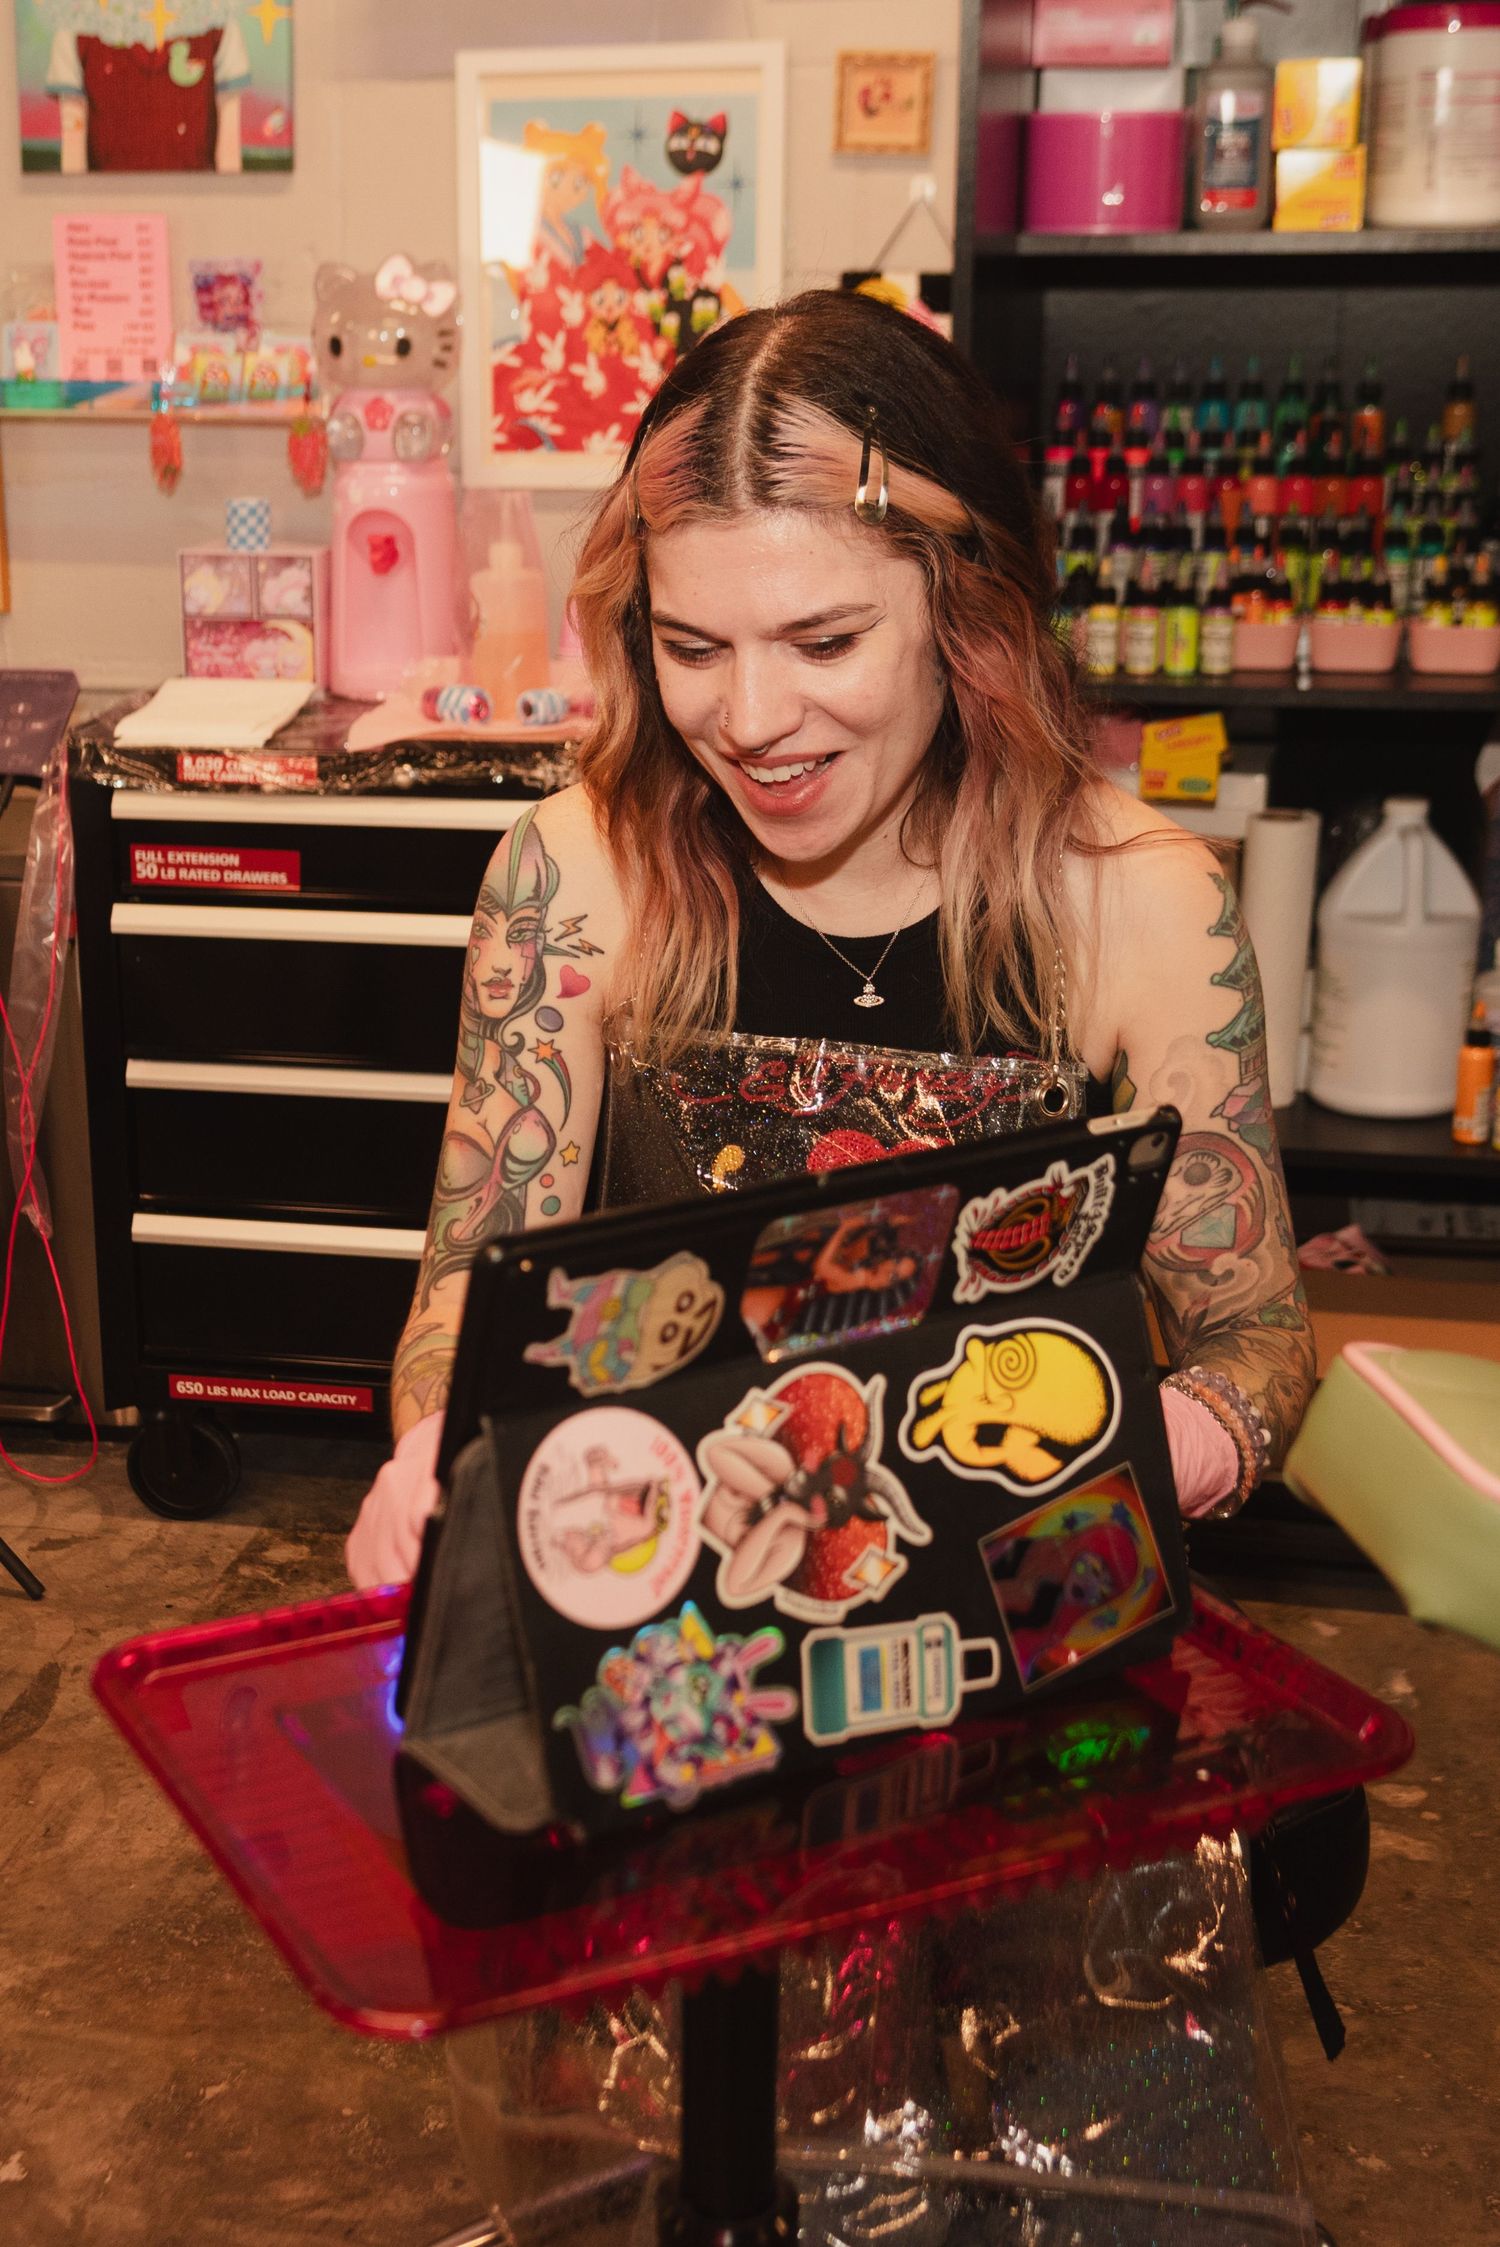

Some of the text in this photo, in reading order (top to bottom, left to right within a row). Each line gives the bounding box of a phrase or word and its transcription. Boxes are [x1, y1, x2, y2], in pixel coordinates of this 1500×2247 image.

[134, 849, 240, 867] FULL EXTENSION
[135, 862, 288, 885] 50 LB RATED DRAWERS
[176, 1380, 357, 1406] 650 LBS MAX LOAD CAPACITY
